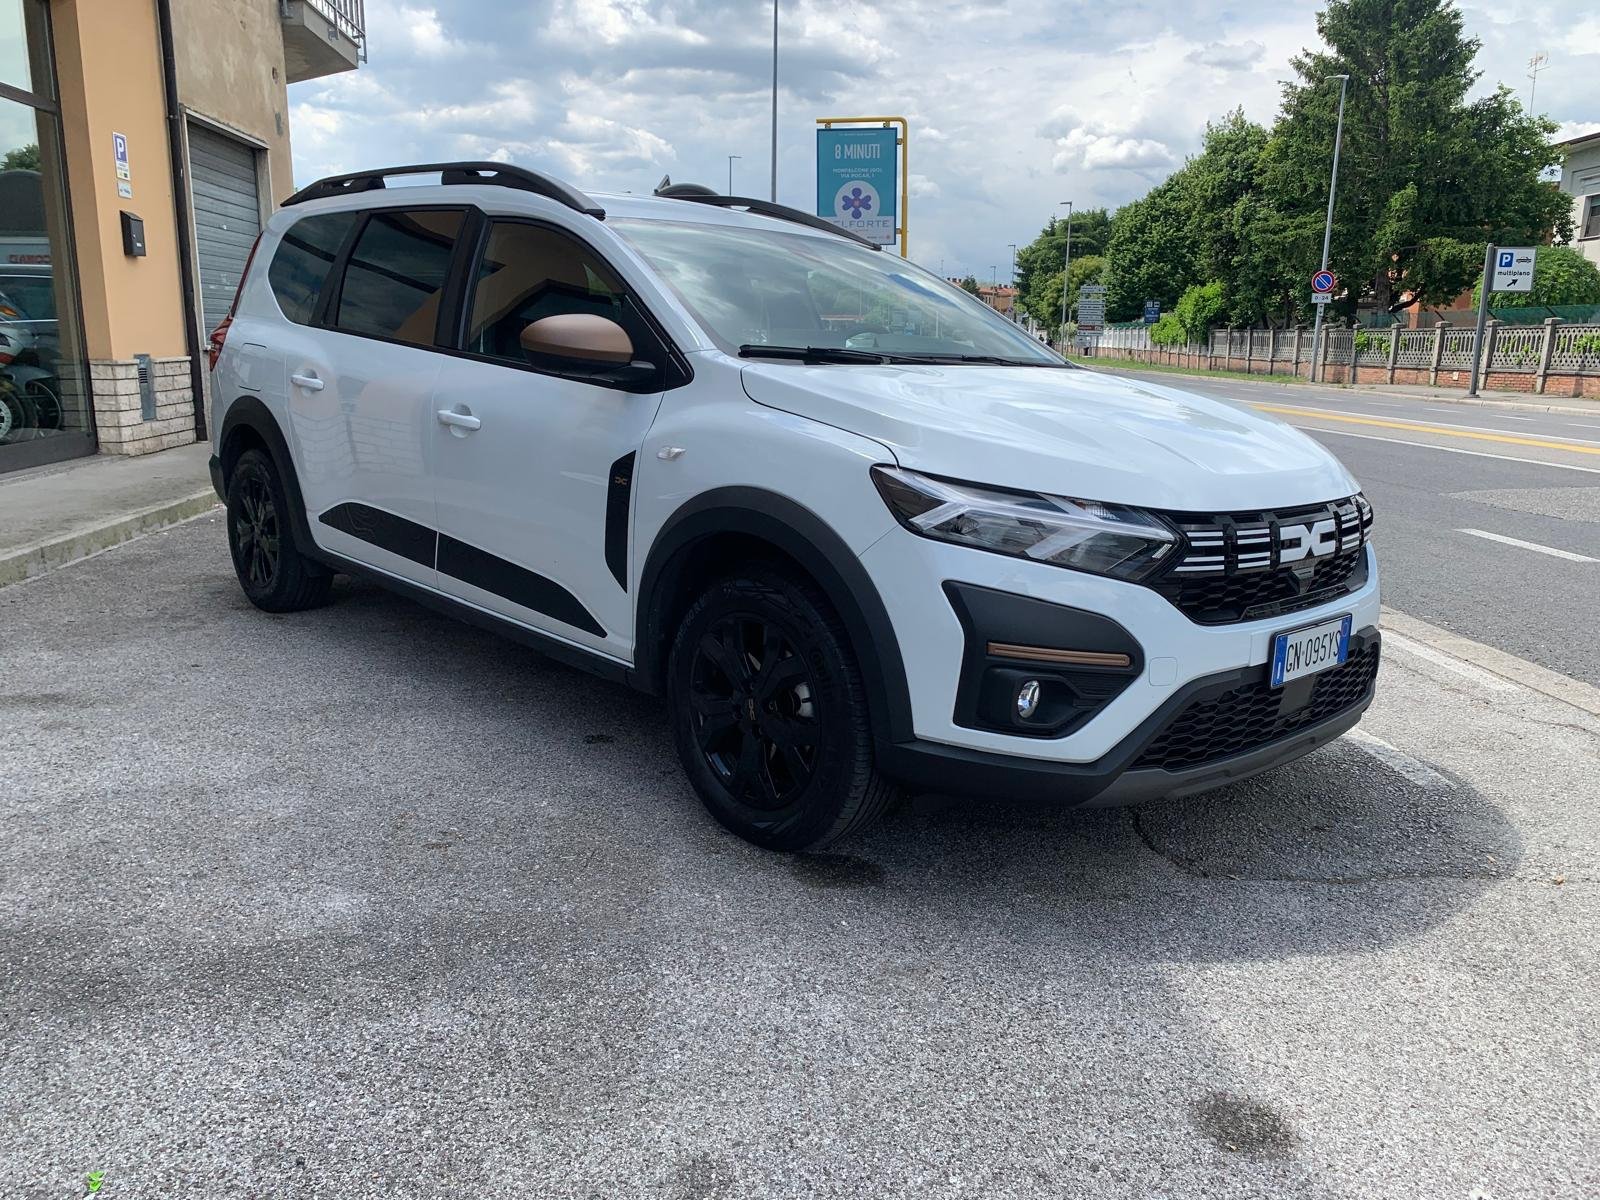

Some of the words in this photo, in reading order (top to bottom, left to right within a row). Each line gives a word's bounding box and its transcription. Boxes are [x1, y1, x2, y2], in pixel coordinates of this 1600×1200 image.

[116, 138, 125, 159] P
[834, 144, 841, 159] 8
[844, 143, 880, 159] MINUTI
[1501, 254, 1511, 266] P
[1304, 630, 1341, 667] 095YS
